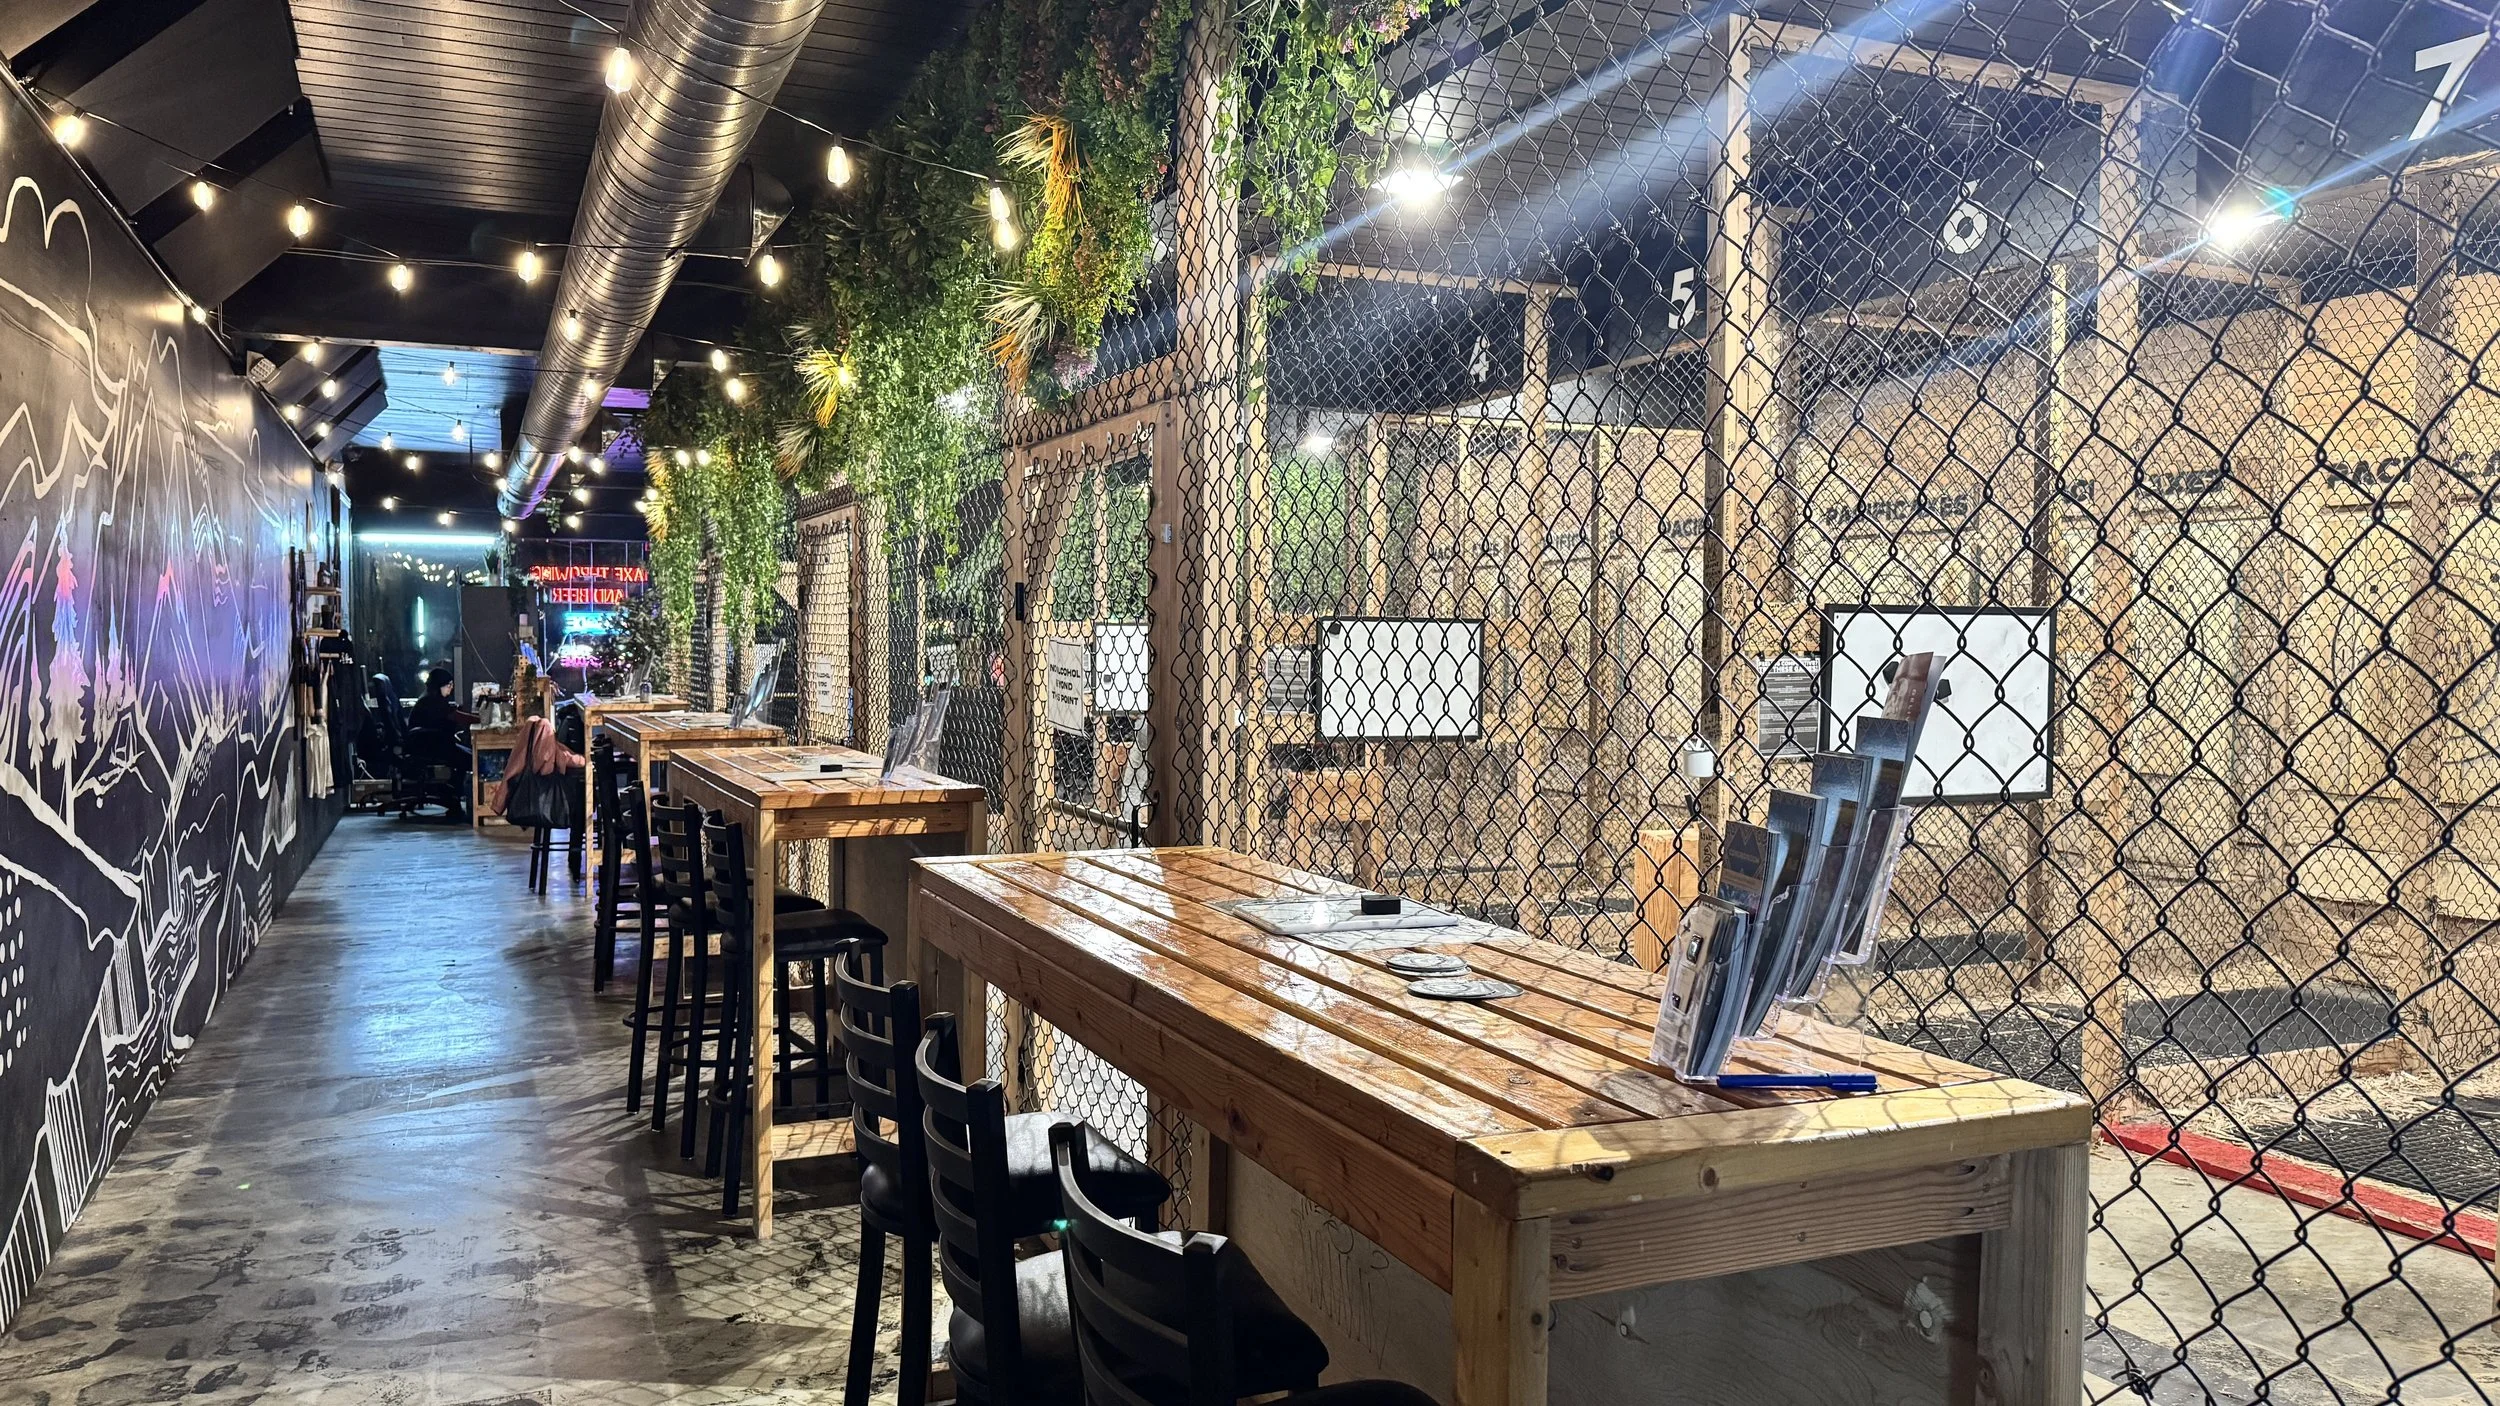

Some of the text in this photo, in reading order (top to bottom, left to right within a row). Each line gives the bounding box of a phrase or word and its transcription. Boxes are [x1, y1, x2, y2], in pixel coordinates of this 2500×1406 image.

[2408, 31, 2491, 141] 7
[1943, 179, 1988, 254] 6
[1668, 266, 1696, 330] 5
[1467, 335, 1490, 383] 4
[1061, 695, 1079, 705] POINT
